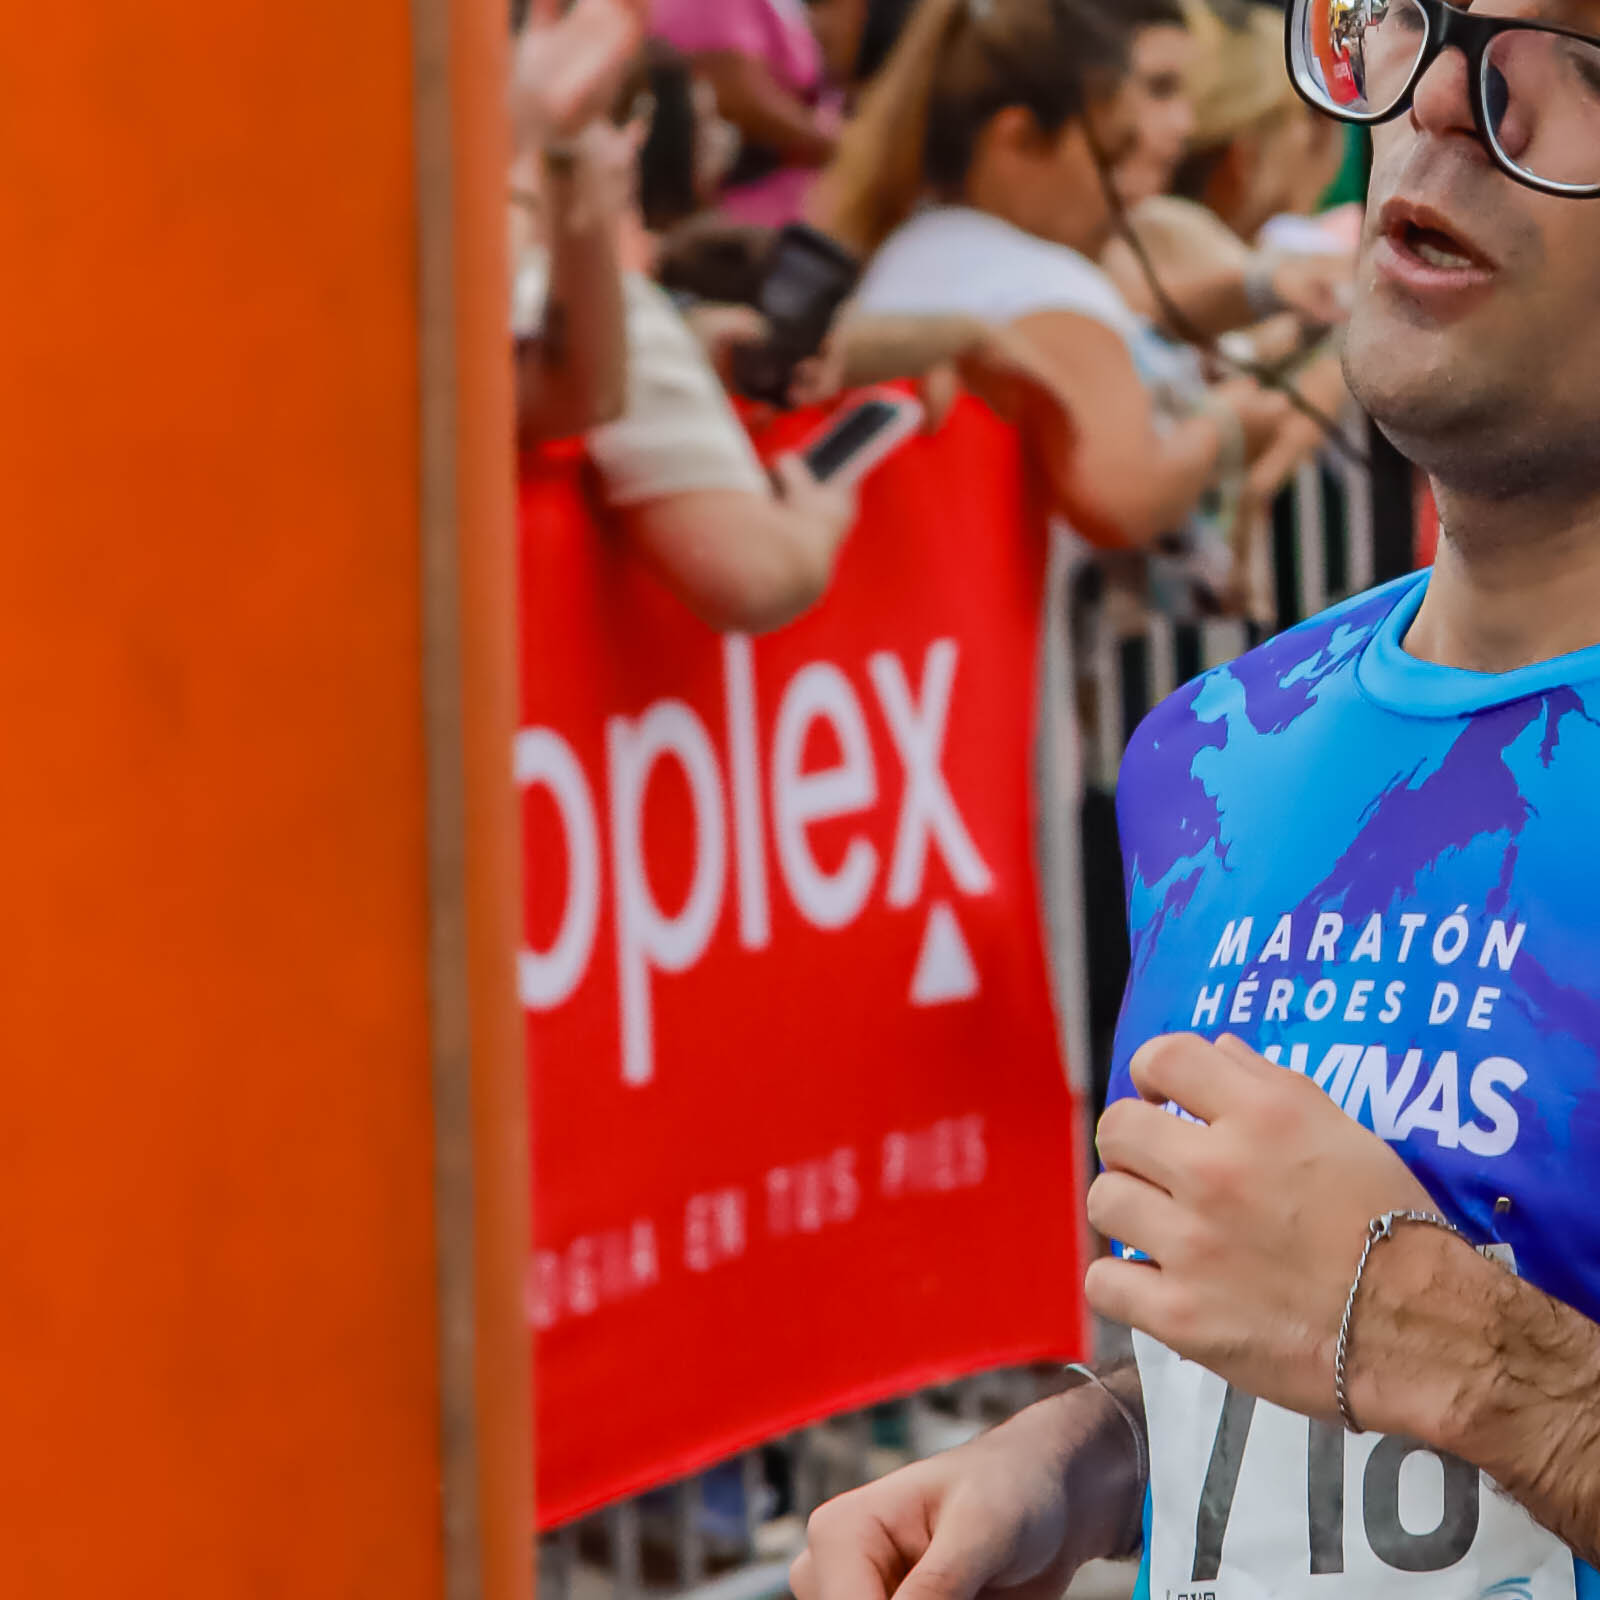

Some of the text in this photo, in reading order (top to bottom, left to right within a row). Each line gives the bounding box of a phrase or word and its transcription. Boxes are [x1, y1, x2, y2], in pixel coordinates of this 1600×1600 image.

[1209, 904, 1526, 971] MARATÓN
[1191, 972, 1501, 1030] HÉROES DE
